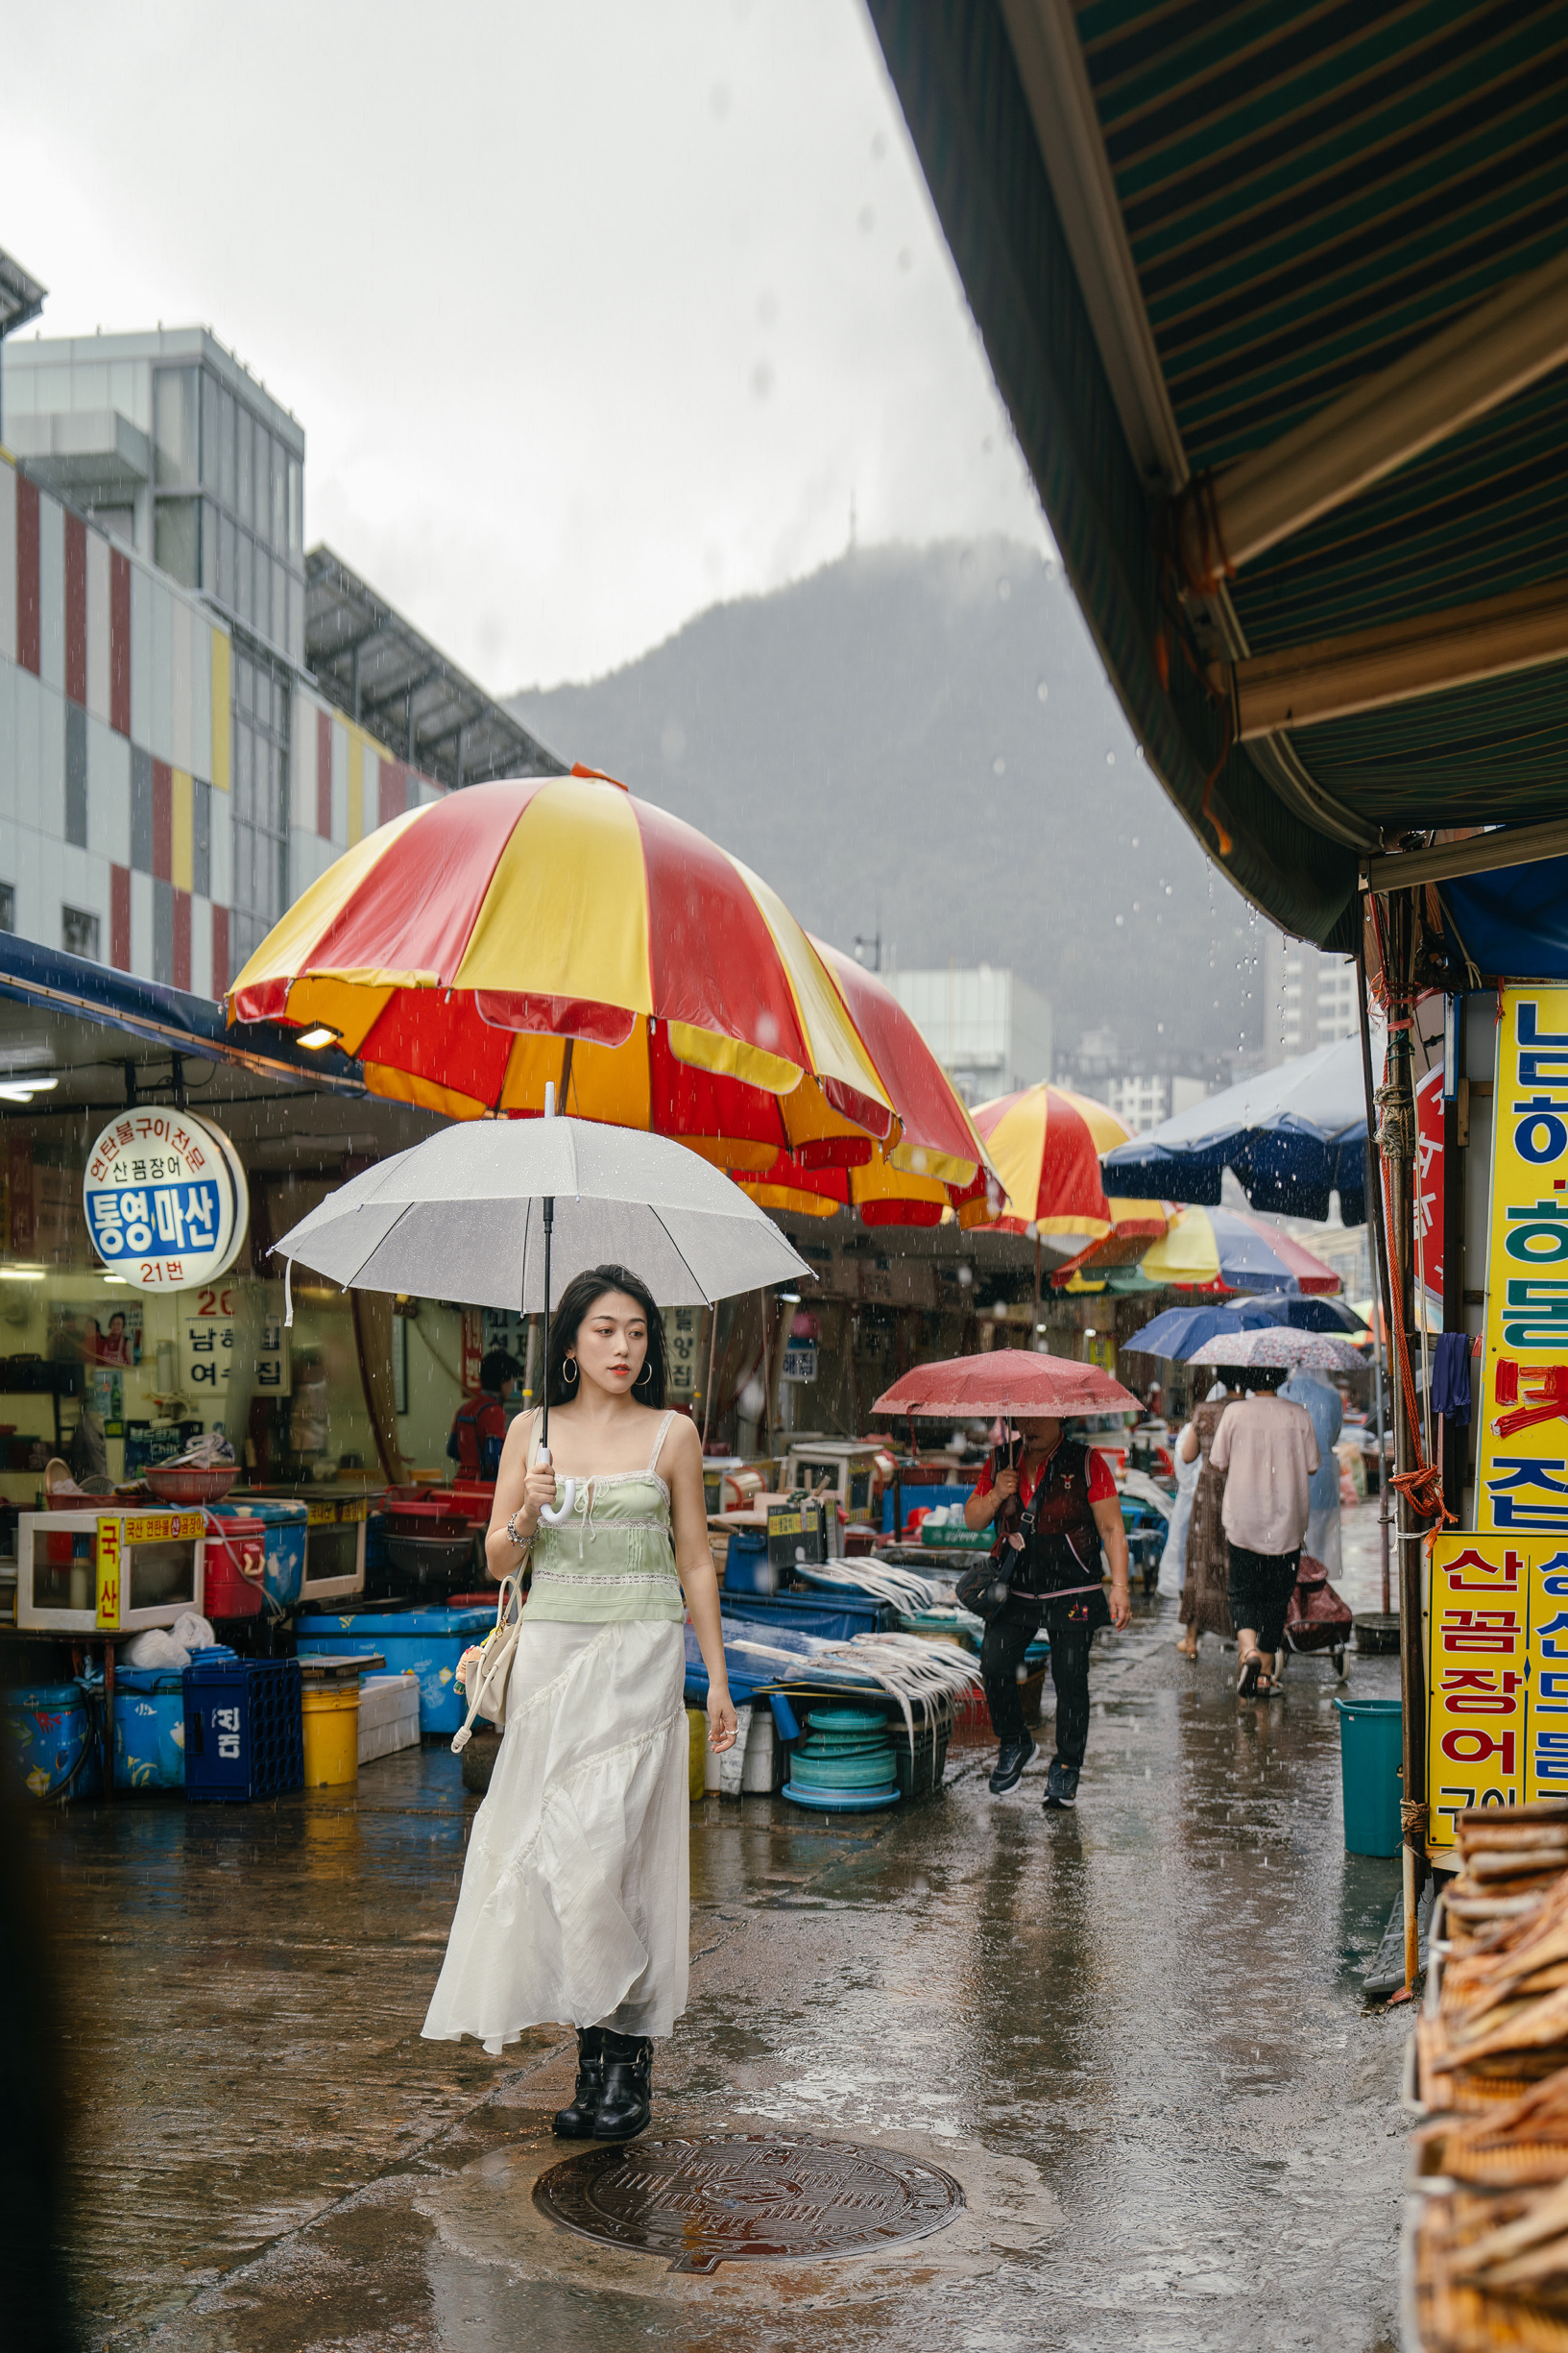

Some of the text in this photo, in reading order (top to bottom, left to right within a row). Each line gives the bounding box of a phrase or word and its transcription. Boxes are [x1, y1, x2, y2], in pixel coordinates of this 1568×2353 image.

[93, 1191, 153, 1254] 통영
[154, 1186, 214, 1249] 마산
[127, 1521, 143, 1539] 국산
[101, 1525, 117, 1618] 국산
[1440, 1549, 1525, 1777] 산꼼장어
[217, 1707, 241, 1759] 대선
